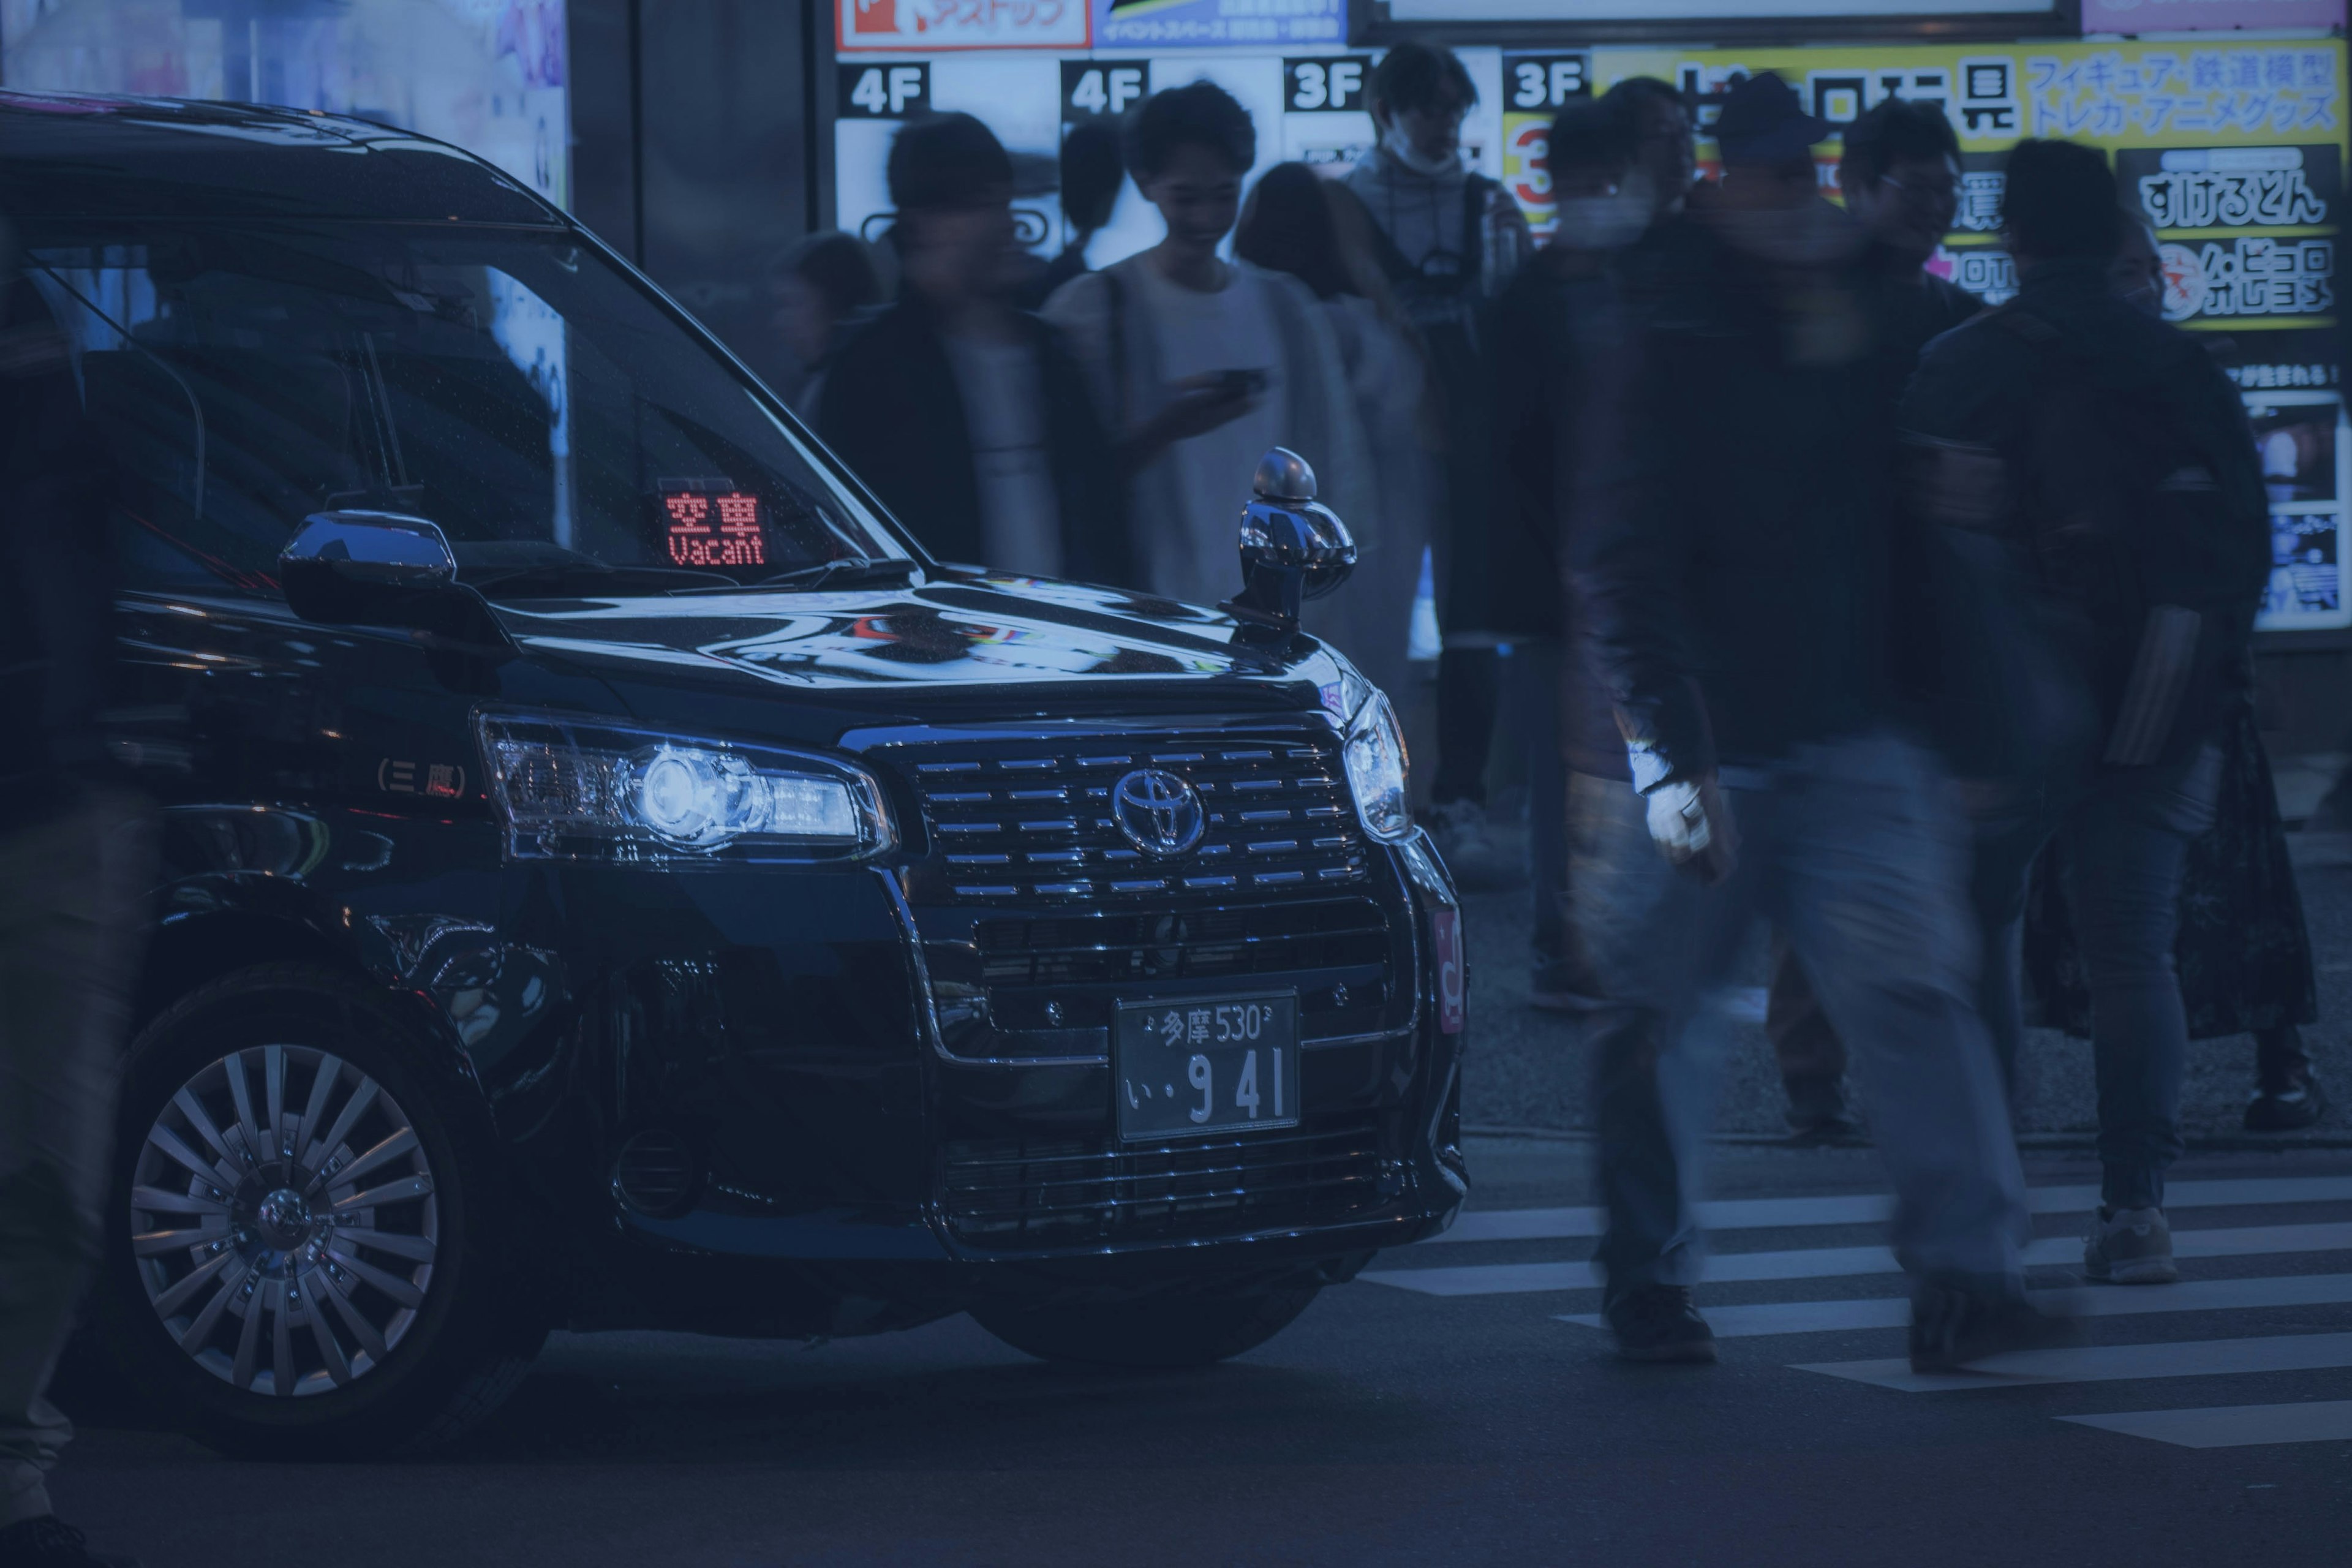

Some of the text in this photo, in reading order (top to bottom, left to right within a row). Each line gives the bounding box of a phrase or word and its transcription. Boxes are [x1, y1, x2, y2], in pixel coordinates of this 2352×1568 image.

[852, 68, 922, 113] 4F
[1072, 69, 1142, 113] 4F
[1293, 62, 1363, 109] 3F
[1513, 62, 1583, 108] 3F
[666, 492, 761, 537] 空車
[668, 535, 765, 565] Vacant
